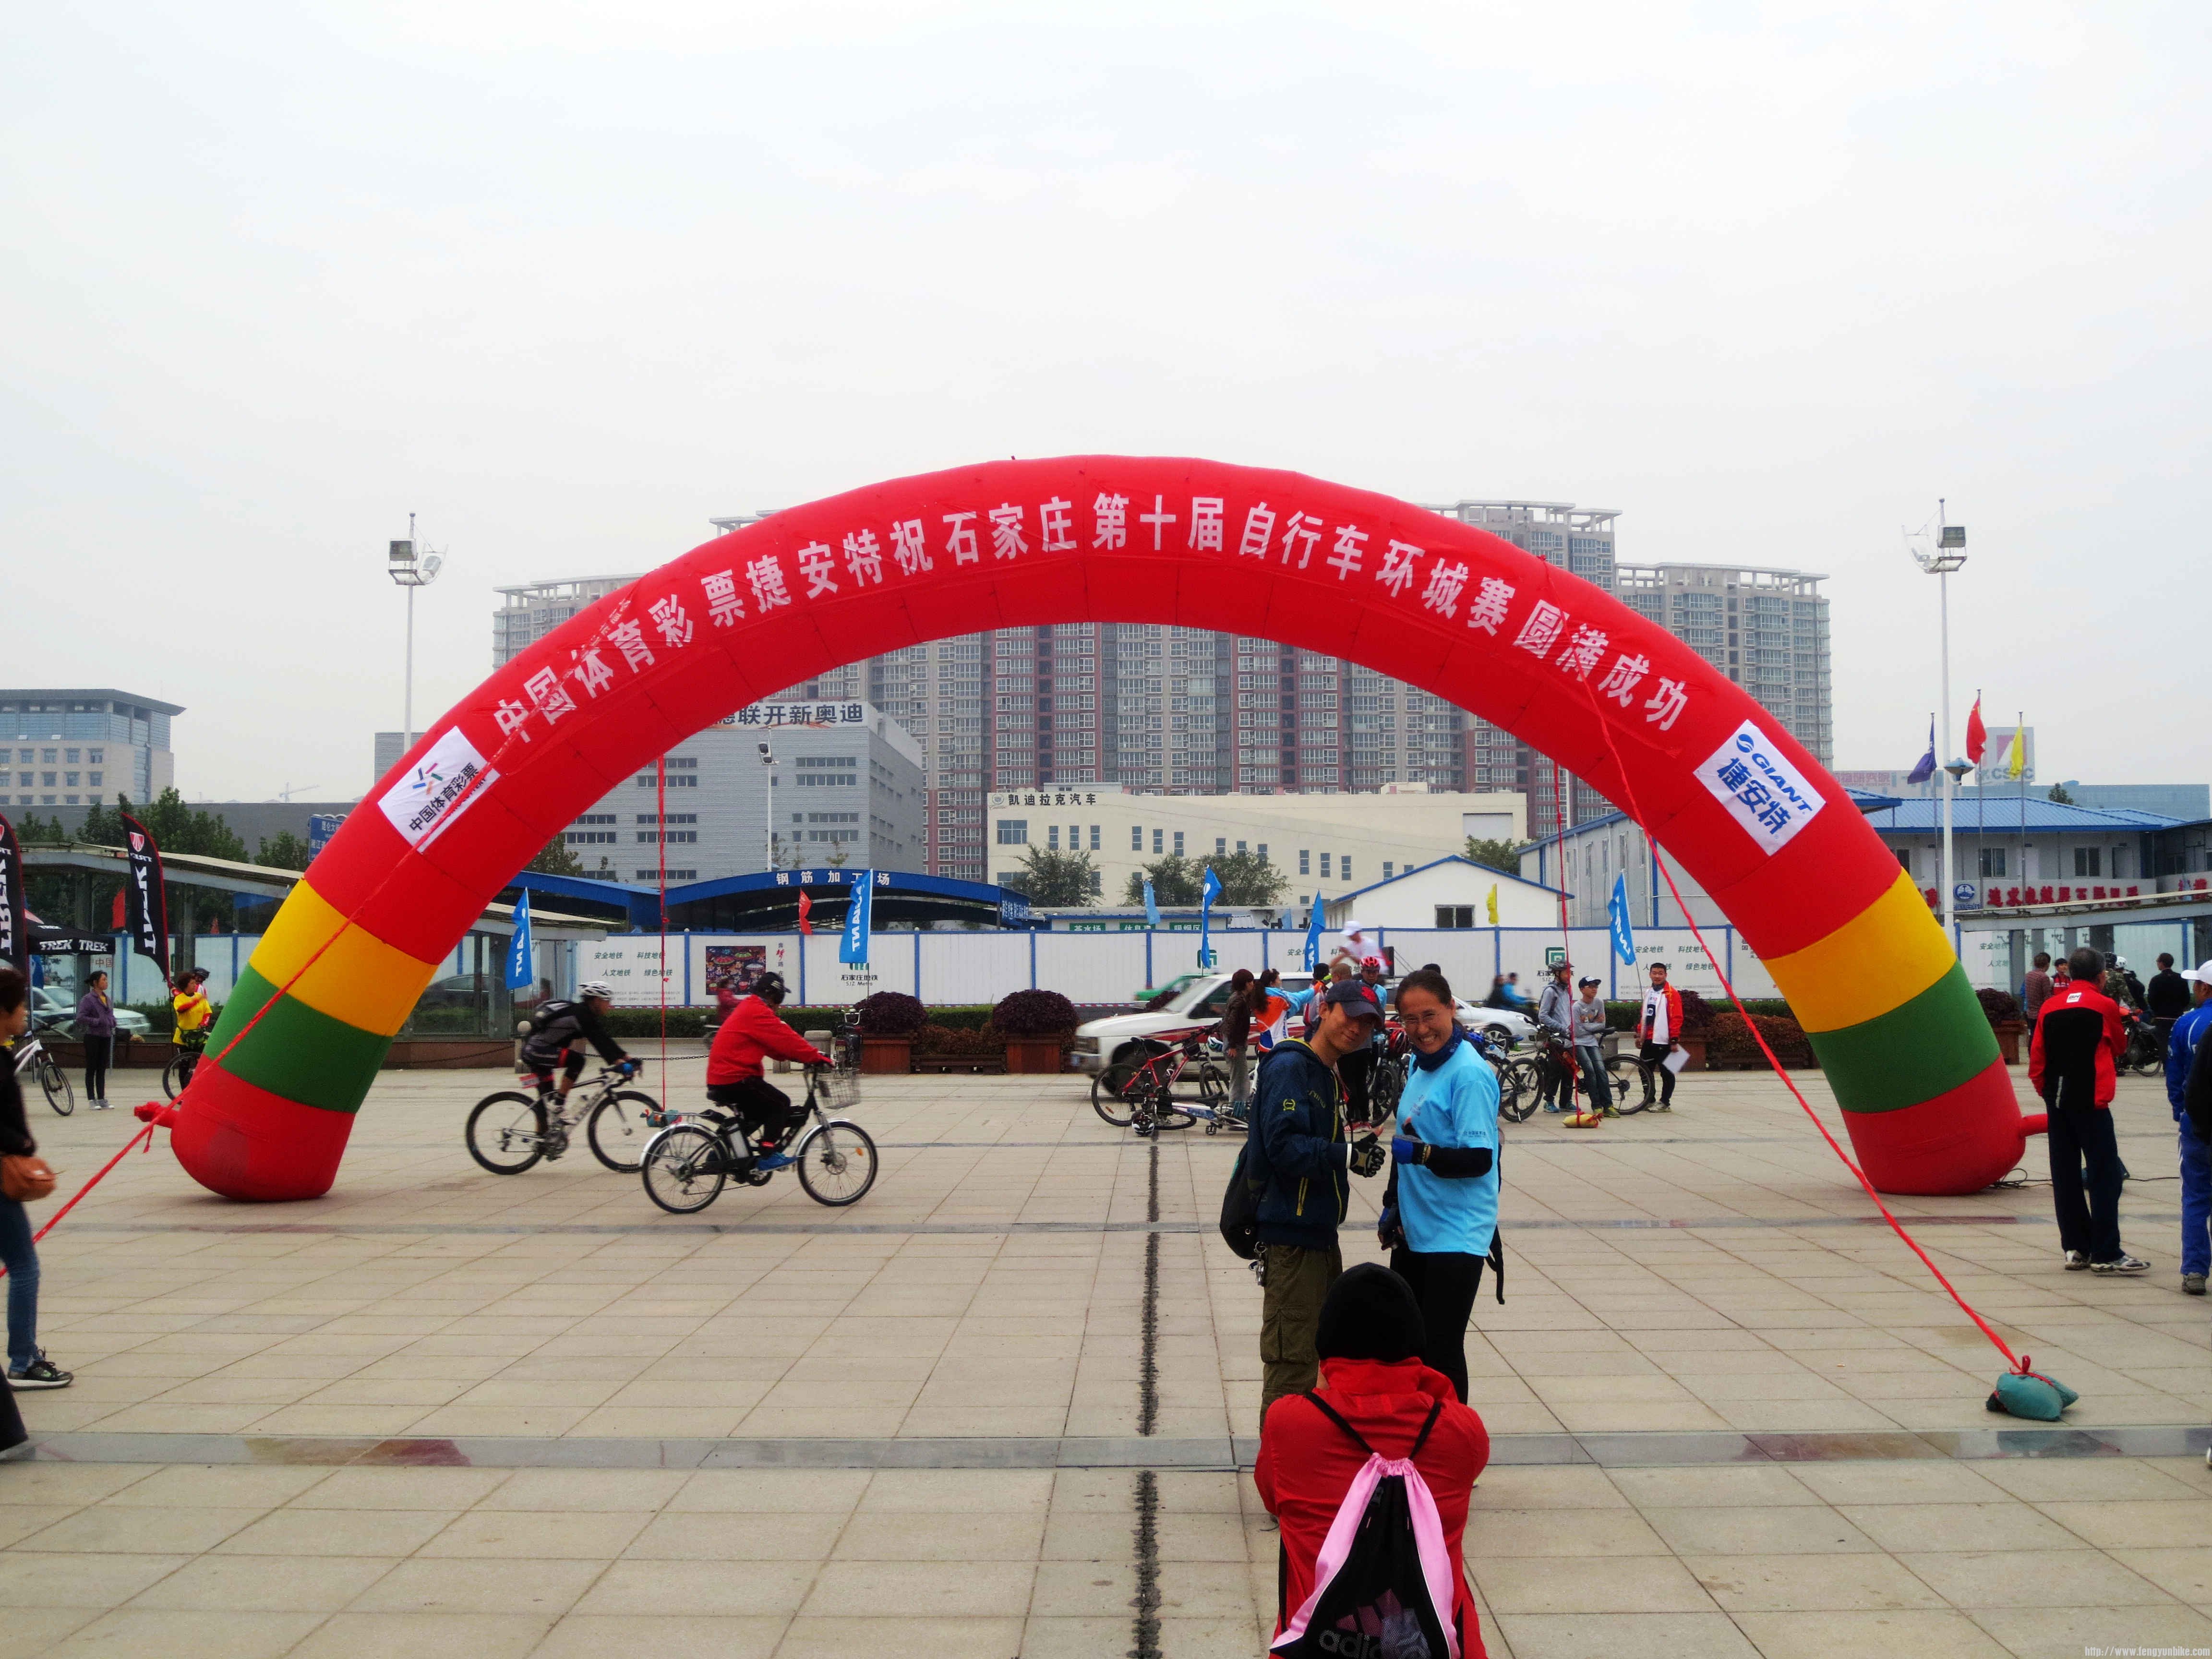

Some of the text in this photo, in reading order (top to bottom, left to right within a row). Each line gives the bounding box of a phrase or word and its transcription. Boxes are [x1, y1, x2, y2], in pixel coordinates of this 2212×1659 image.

[1991, 767, 2034, 780] CSC
[1752, 753, 1813, 812] GIANT
[408, 762, 480, 831] 中国体育彩票
[1008, 793, 1096, 806] 凯迪拉克汽车
[776, 870, 890, 886] 钢筋加工场
[39, 938, 109, 952] TREK TREK
[1635, 945, 1664, 953] 安全地铁
[594, 951, 623, 960] 安全地铁
[601, 968, 631, 976] 人文地铁
